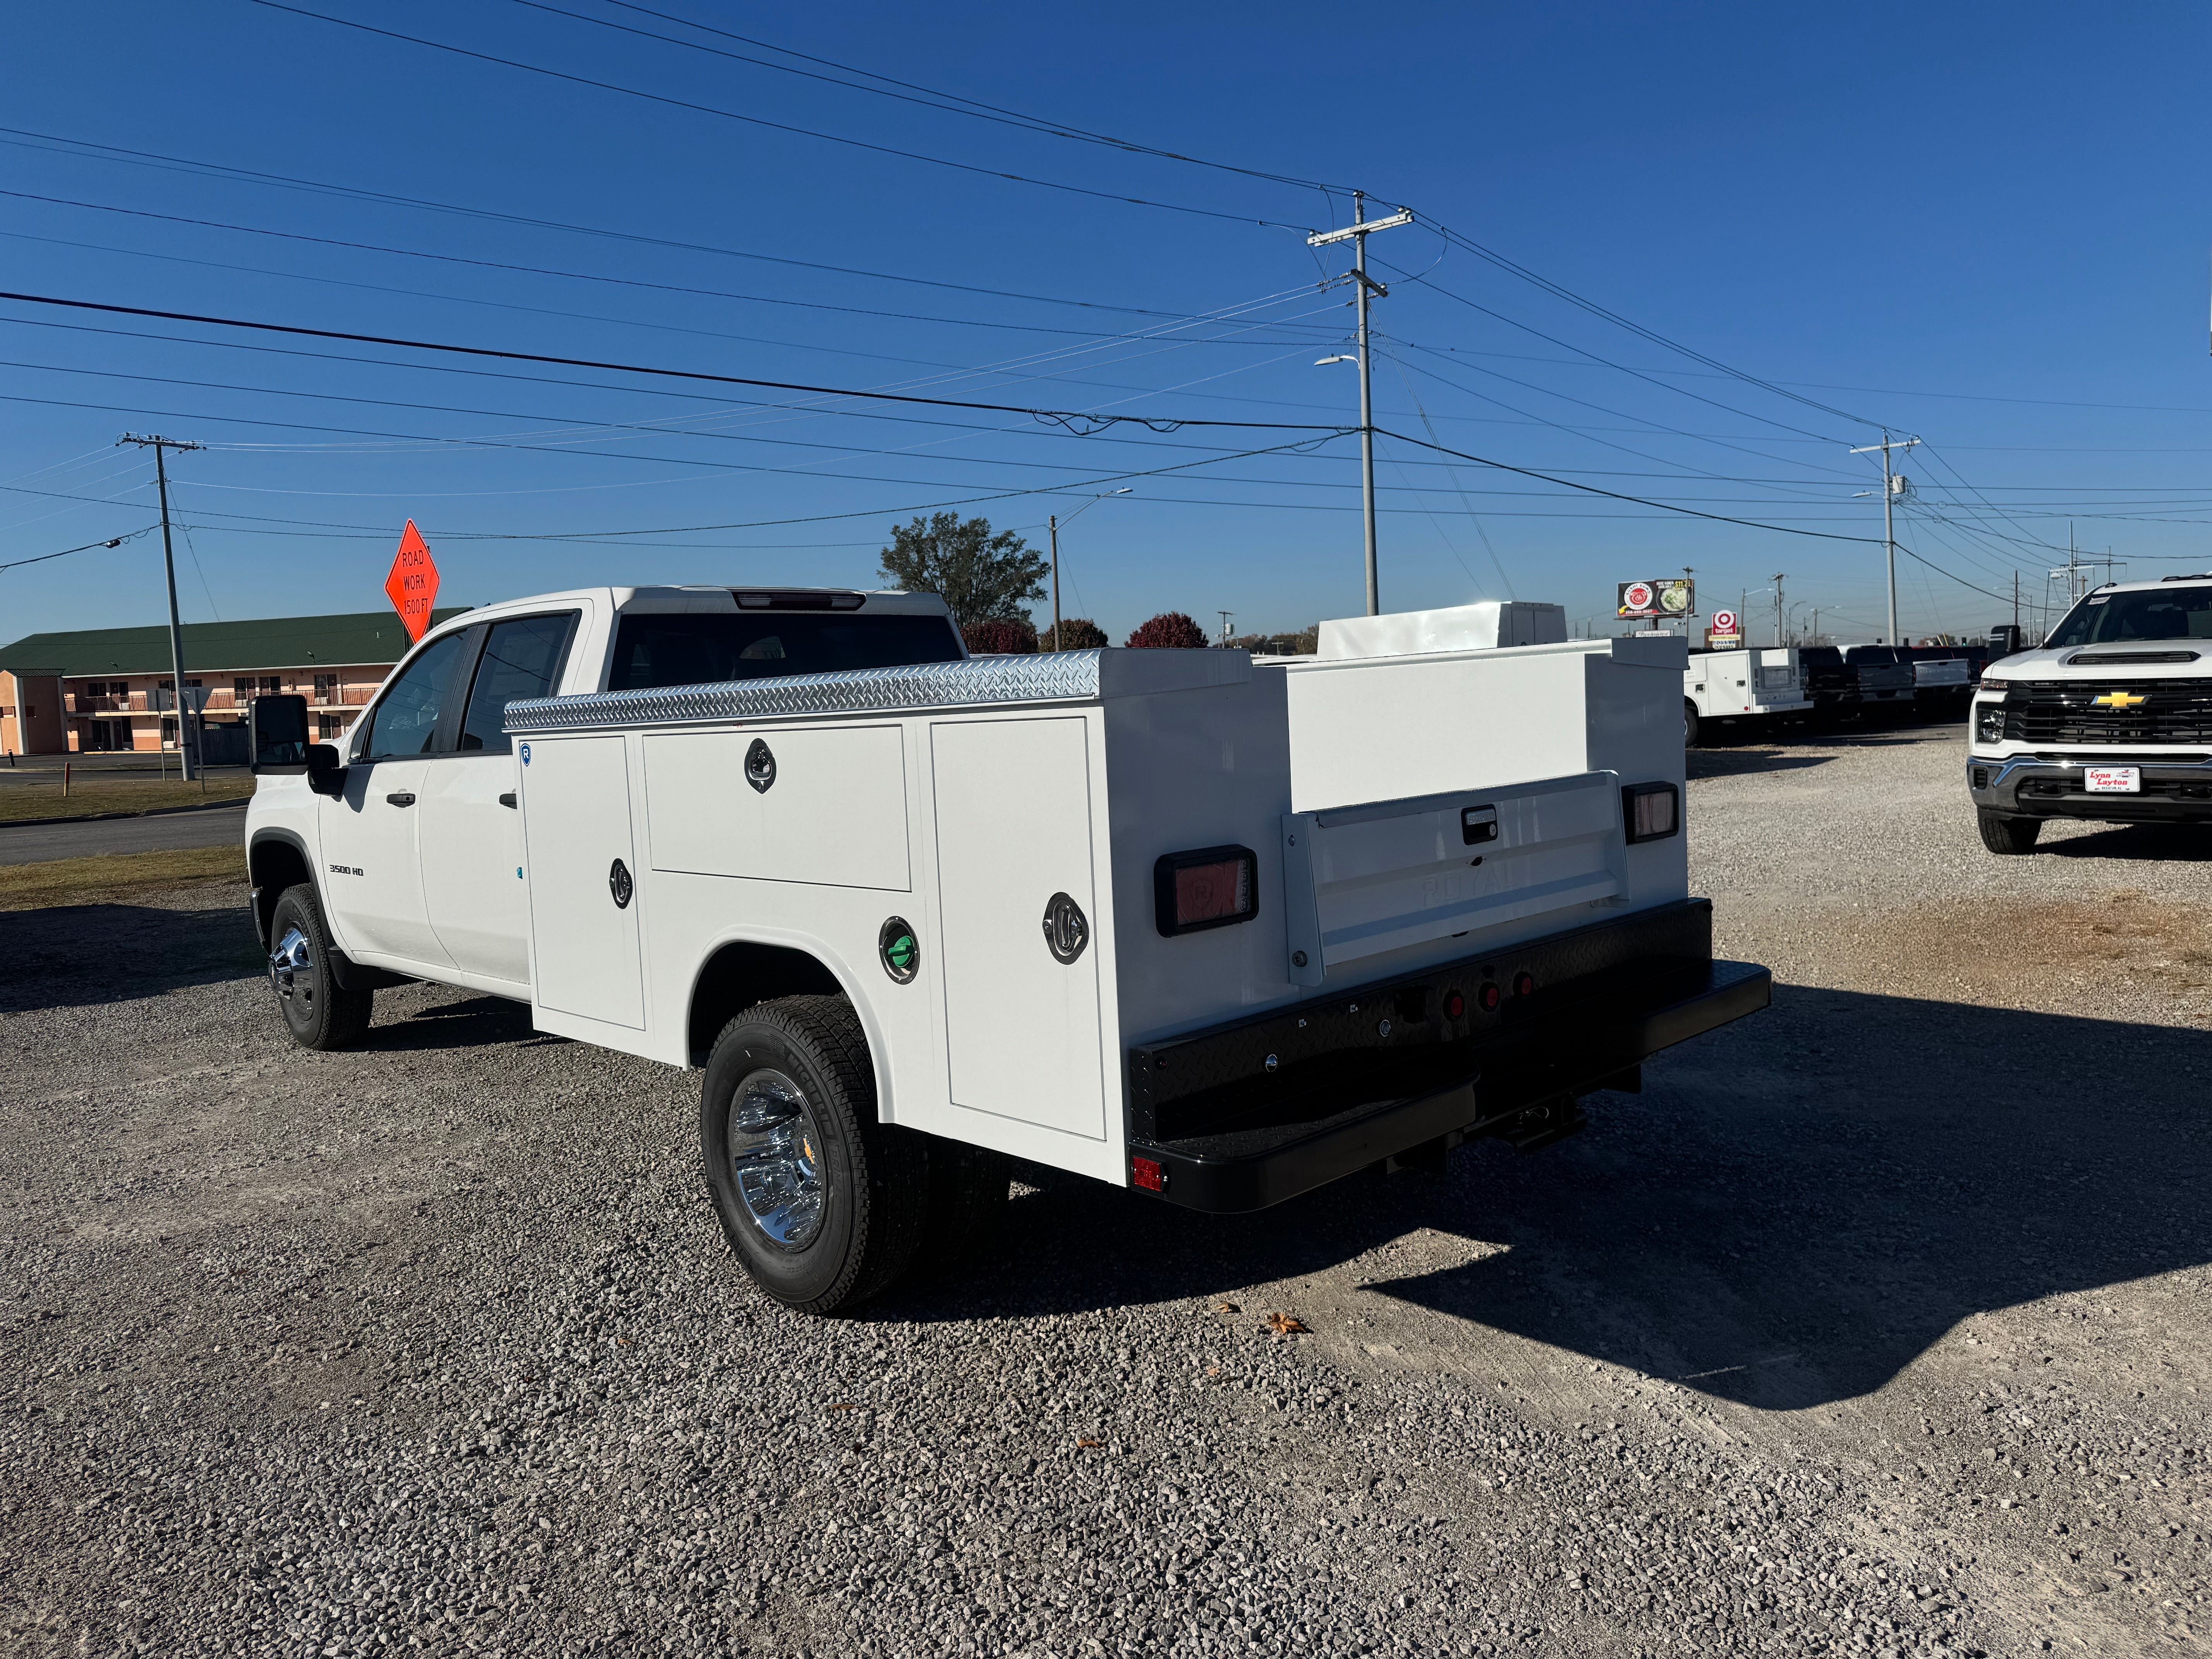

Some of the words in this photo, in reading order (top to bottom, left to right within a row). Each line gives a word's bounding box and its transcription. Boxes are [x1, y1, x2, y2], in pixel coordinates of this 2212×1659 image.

[402, 550, 424, 567] ROAD
[404, 574, 425, 591] WORK
[404, 599, 420, 615] 1500
[421, 598, 428, 613] FT
[523, 749, 529, 759] R
[329, 865, 350, 874] 3500
[352, 867, 364, 876] HD
[1423, 862, 1517, 907] ROYAL
[786, 1053, 834, 1136] MICHELIN
